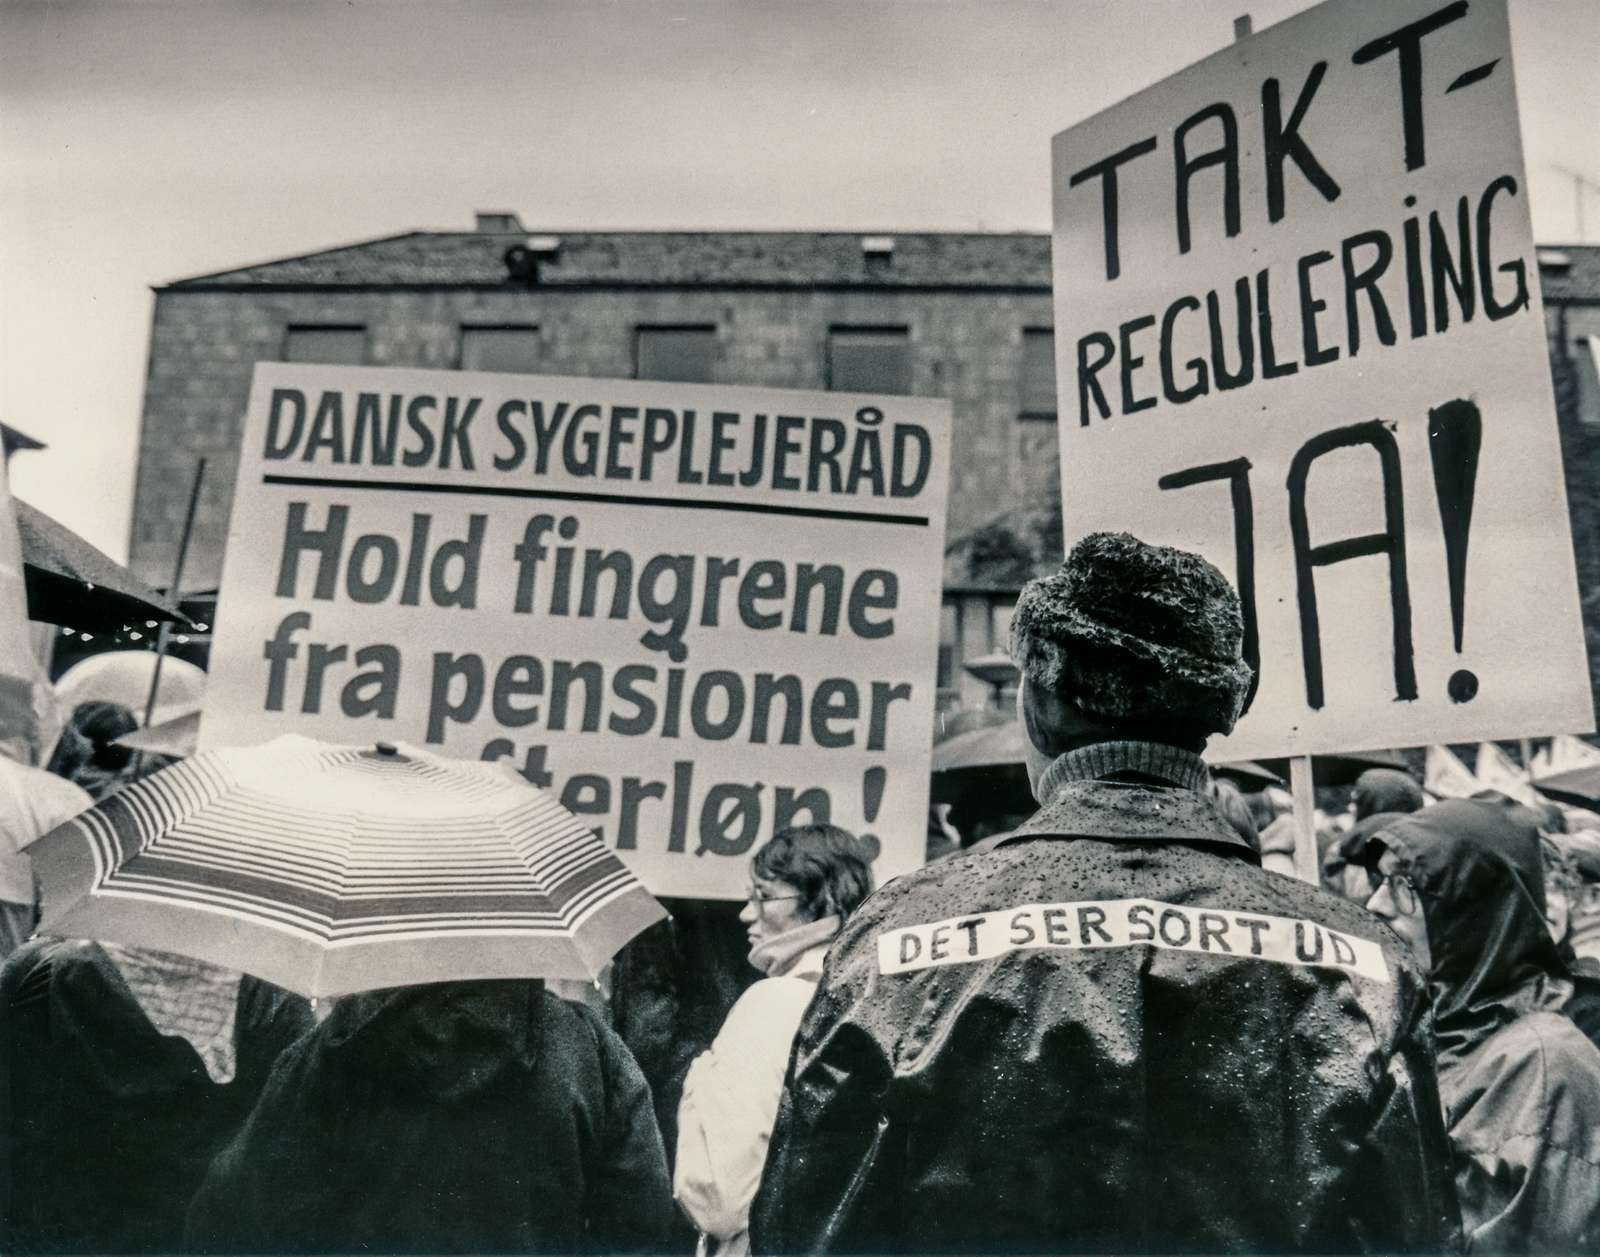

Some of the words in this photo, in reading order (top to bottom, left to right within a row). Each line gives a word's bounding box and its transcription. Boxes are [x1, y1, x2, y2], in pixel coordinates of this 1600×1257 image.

[1069, 1, 1502, 281] TAKT-
[264, 387, 482, 471] DANSK
[493, 399, 932, 498] SYGEPLEJERÅD
[275, 502, 488, 610] Hold
[513, 515, 898, 652] fingrene
[1158, 393, 1482, 718] JA!
[264, 612, 402, 719] fra
[425, 641, 911, 751] pensioner
[899, 918, 986, 965] DET
[1009, 906, 1112, 946] SER
[1128, 905, 1270, 956] SORT
[1295, 923, 1357, 966] UD
